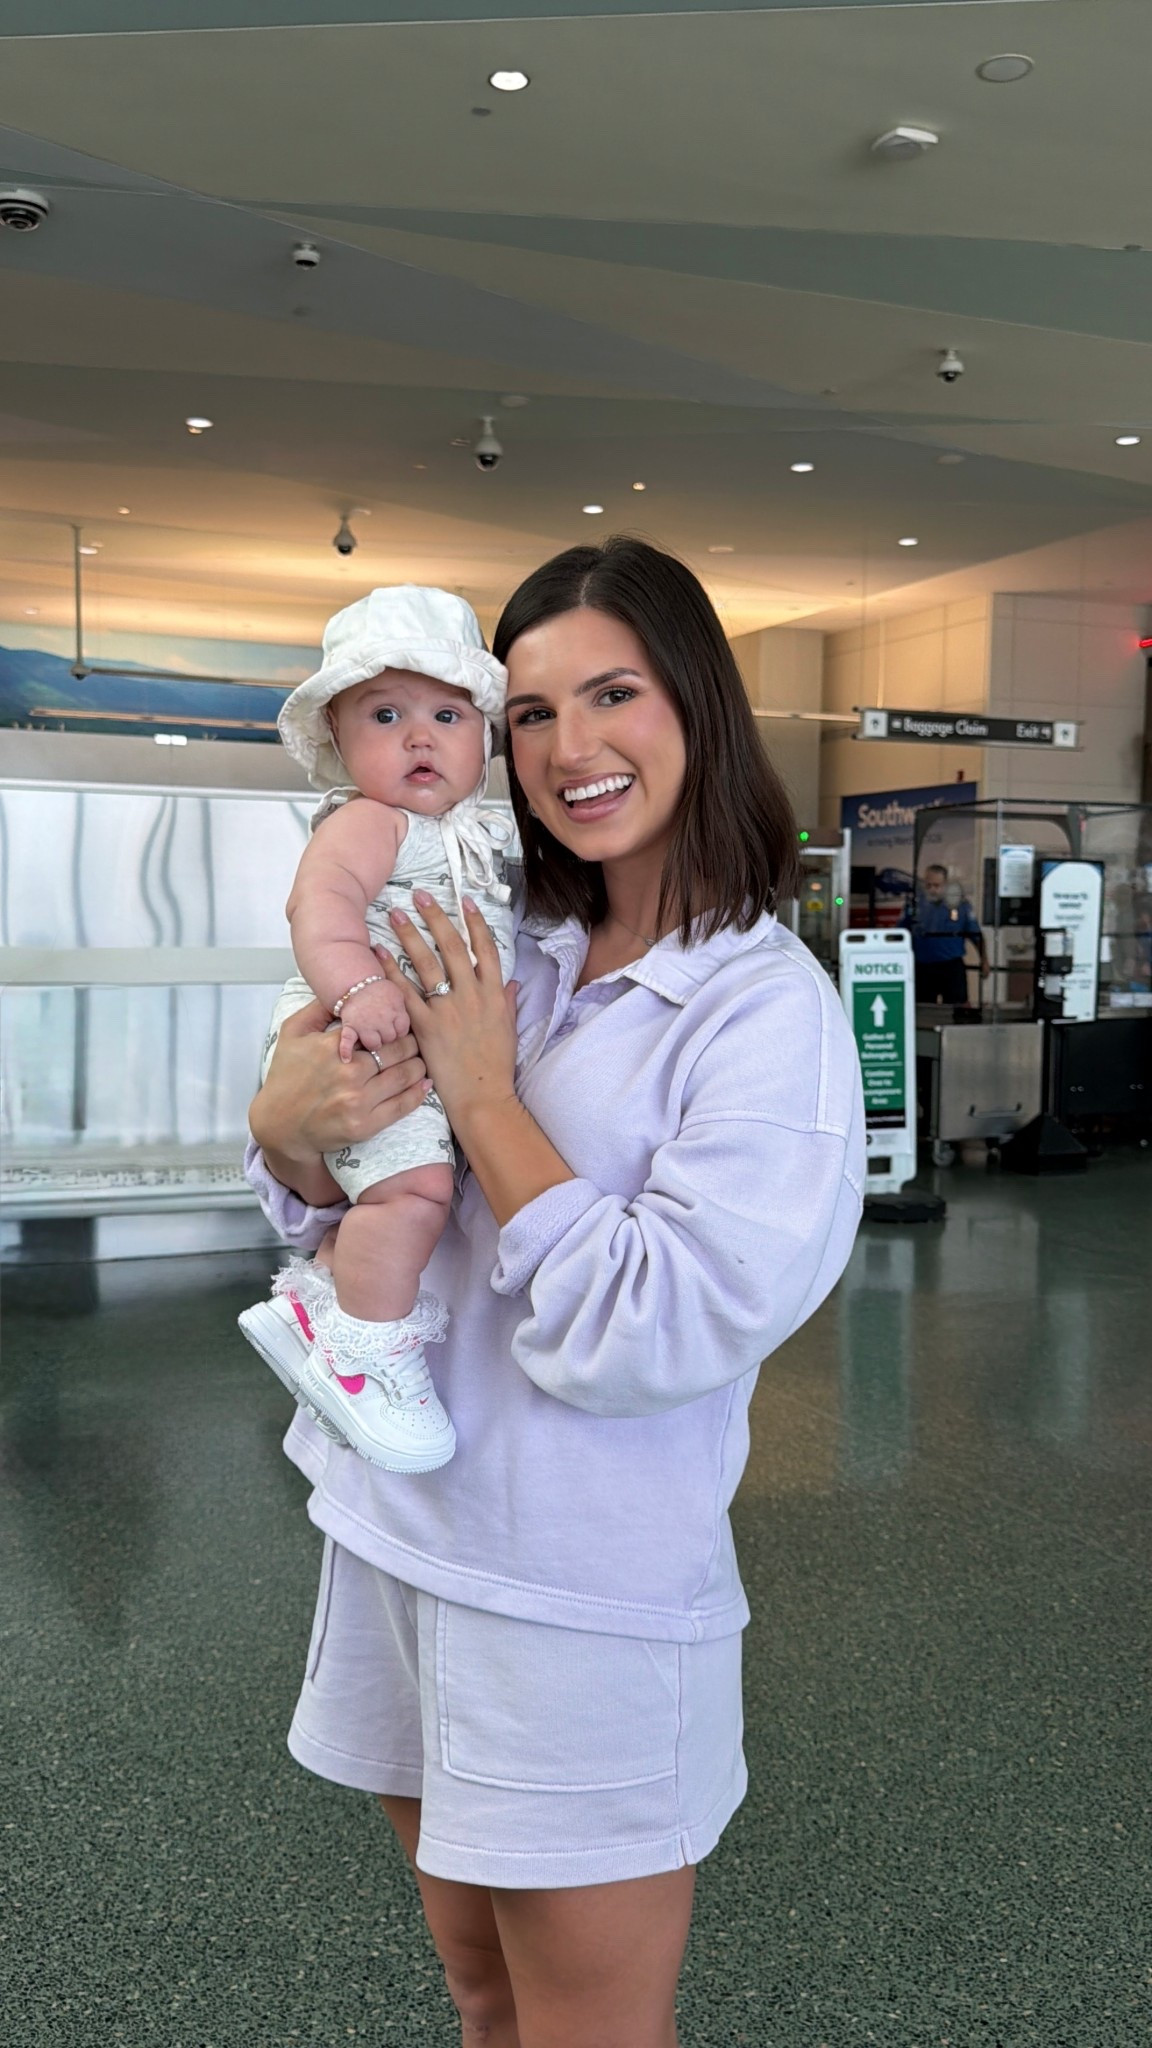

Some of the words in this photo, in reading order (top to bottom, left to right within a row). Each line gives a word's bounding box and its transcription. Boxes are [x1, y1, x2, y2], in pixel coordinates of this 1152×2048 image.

[903, 716, 954, 738] Baggage
[955, 719, 989, 736] Claim
[1016, 722, 1039, 739] Exit
